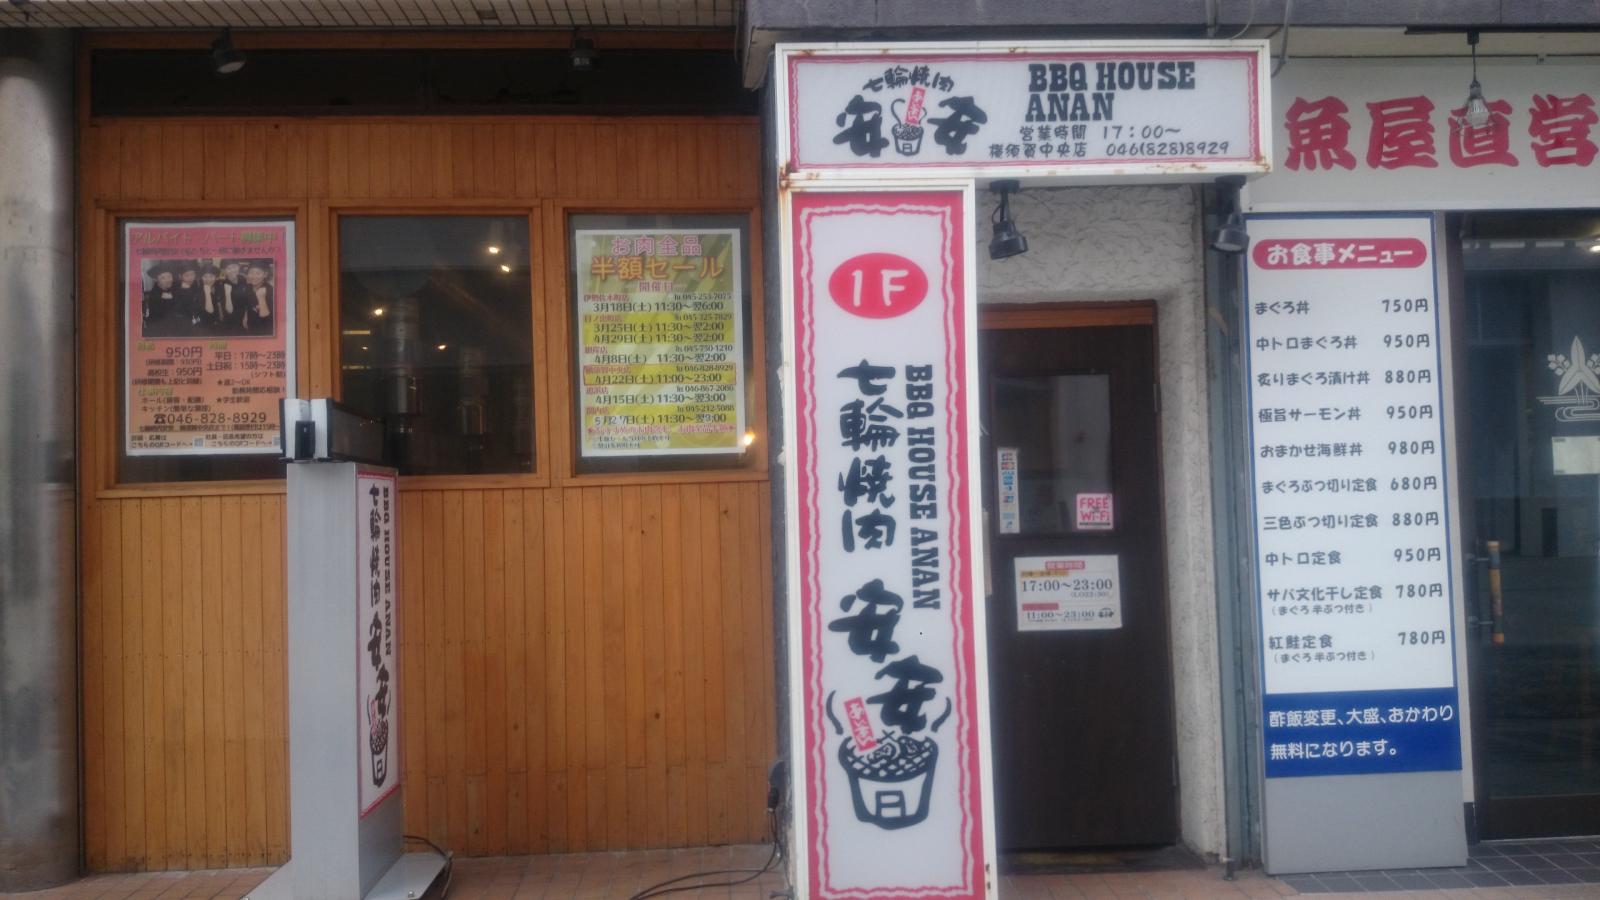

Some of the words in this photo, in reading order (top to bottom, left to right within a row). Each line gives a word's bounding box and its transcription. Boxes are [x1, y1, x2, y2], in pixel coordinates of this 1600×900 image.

[862, 65, 955, 92] 七輪焼肉
[1028, 62, 1088, 92] BBQ
[1096, 61, 1196, 91] HOUSE
[1025, 92, 1115, 123] ANAN
[1019, 124, 1087, 142] 営業時間
[1283, 93, 1600, 172] 魚屋直営
[989, 142, 1087, 159] 横須賀中央店
[1105, 141, 1230, 157] 046(828)8929
[611, 234, 702, 256] お肉全品
[1266, 242, 1414, 266] お食事メニュー
[591, 255, 723, 281] 半額セール
[851, 269, 909, 308] 1F
[1254, 300, 1310, 316] まぐろ丼
[1381, 298, 1429, 313] 750円
[1256, 335, 1358, 351] 中トロまぐろ丼
[1383, 333, 1430, 348] 950円
[166, 346, 203, 359] 950円
[1257, 370, 1371, 387] 炙りまぐろ漬け丼
[1384, 369, 1432, 384] 880円
[905, 364, 934, 420] BBQ
[168, 412, 267, 425] 046-828-8929
[1258, 406, 1362, 423] 極旨サーモン丼
[1386, 404, 1433, 420] 950円
[836, 358, 905, 553] 七輪焼肉
[1259, 441, 1363, 458] おまかせ海鮮丼
[1388, 440, 1435, 455] 980円
[907, 426, 938, 520] HOUSE
[1261, 477, 1378, 494] まぐろぶつ切り定食
[1390, 475, 1438, 491] 680円
[1079, 497, 1109, 509] FREE
[1262, 513, 1379, 530] 三色ぶつ切り定食
[1391, 511, 1439, 527] 880円
[1265, 550, 1342, 566] 中トロ定食
[1393, 547, 1441, 562] 950円
[909, 526, 941, 610] ANAN
[1266, 584, 1383, 602] サバ文化干し定食
[1395, 582, 1443, 598] 780円
[1268, 633, 1334, 650] 紅鮭定食
[1397, 630, 1446, 646] 780円
[1268, 704, 1454, 728] 酢飯変更、大盛、おかわり
[1269, 739, 1397, 761] 無料になります。
